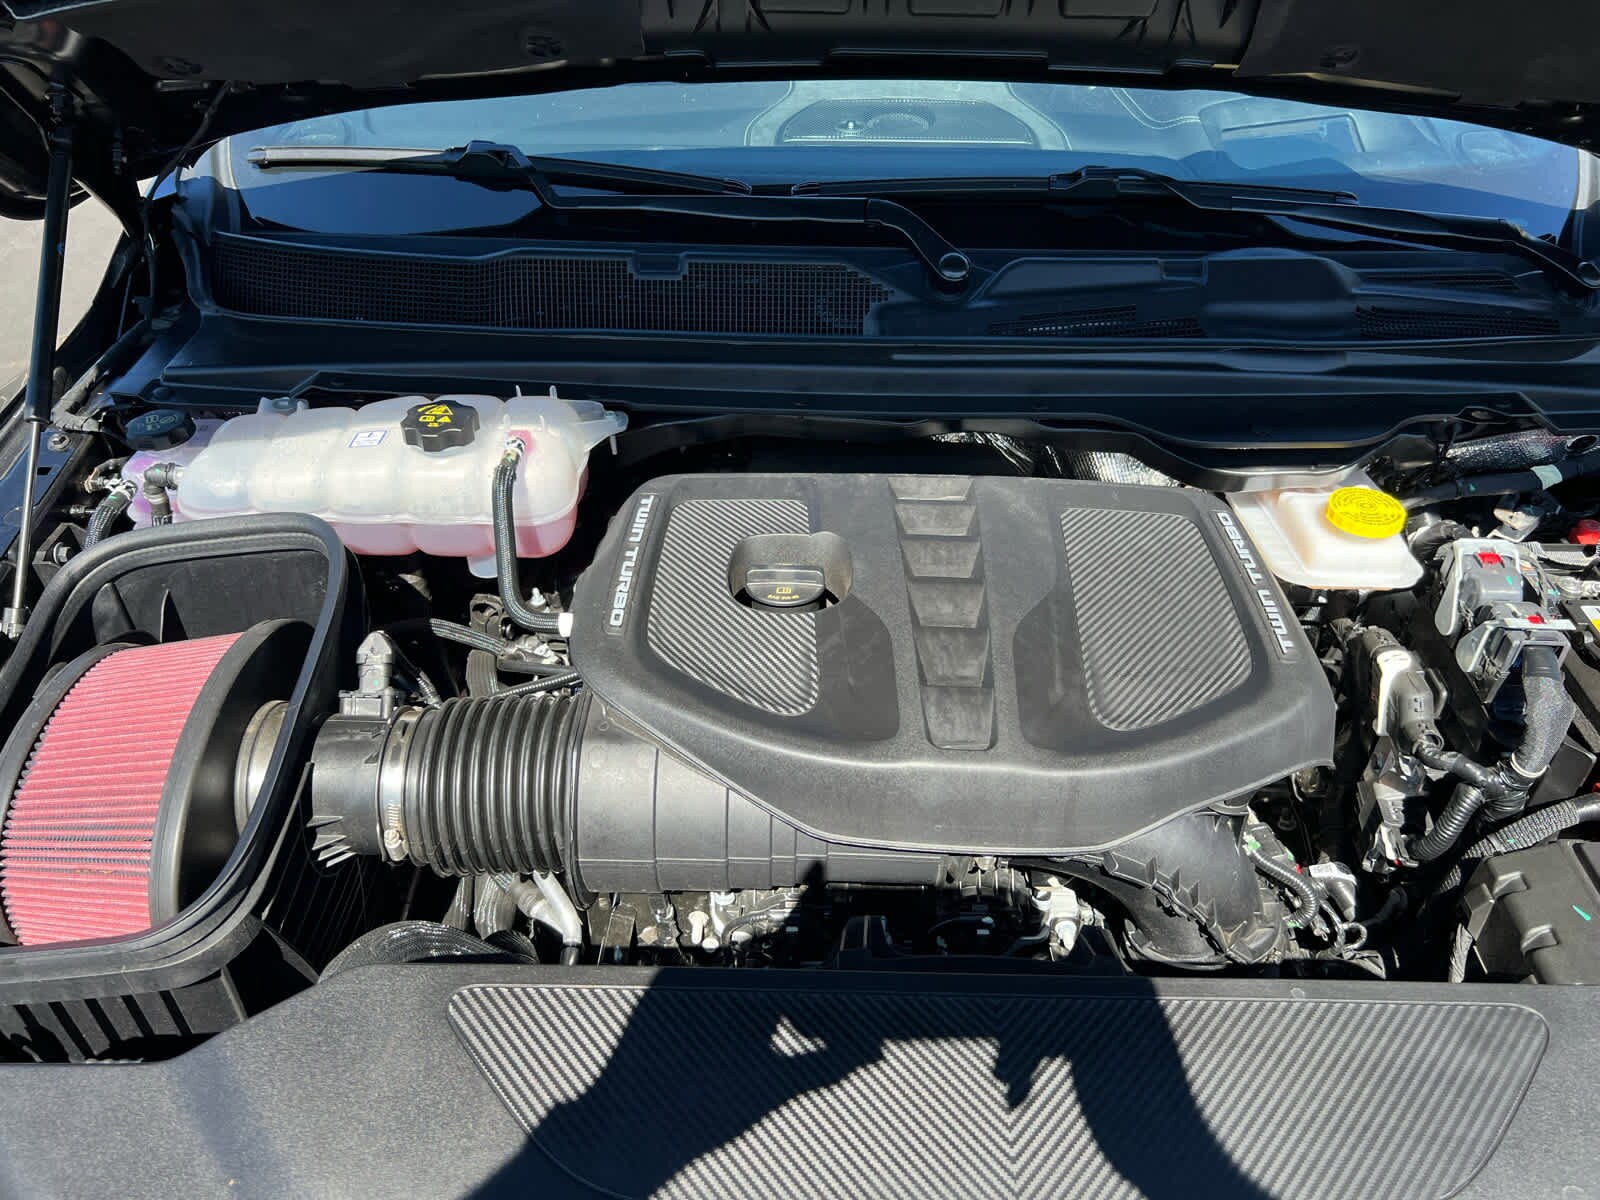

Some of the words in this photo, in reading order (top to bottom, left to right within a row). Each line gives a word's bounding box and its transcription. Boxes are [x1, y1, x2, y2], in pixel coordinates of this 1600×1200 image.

[629, 495, 654, 542] TWIN
[1217, 512, 1263, 585] TURBO
[609, 546, 639, 626] TURBO
[1257, 589, 1294, 654] TWIN
